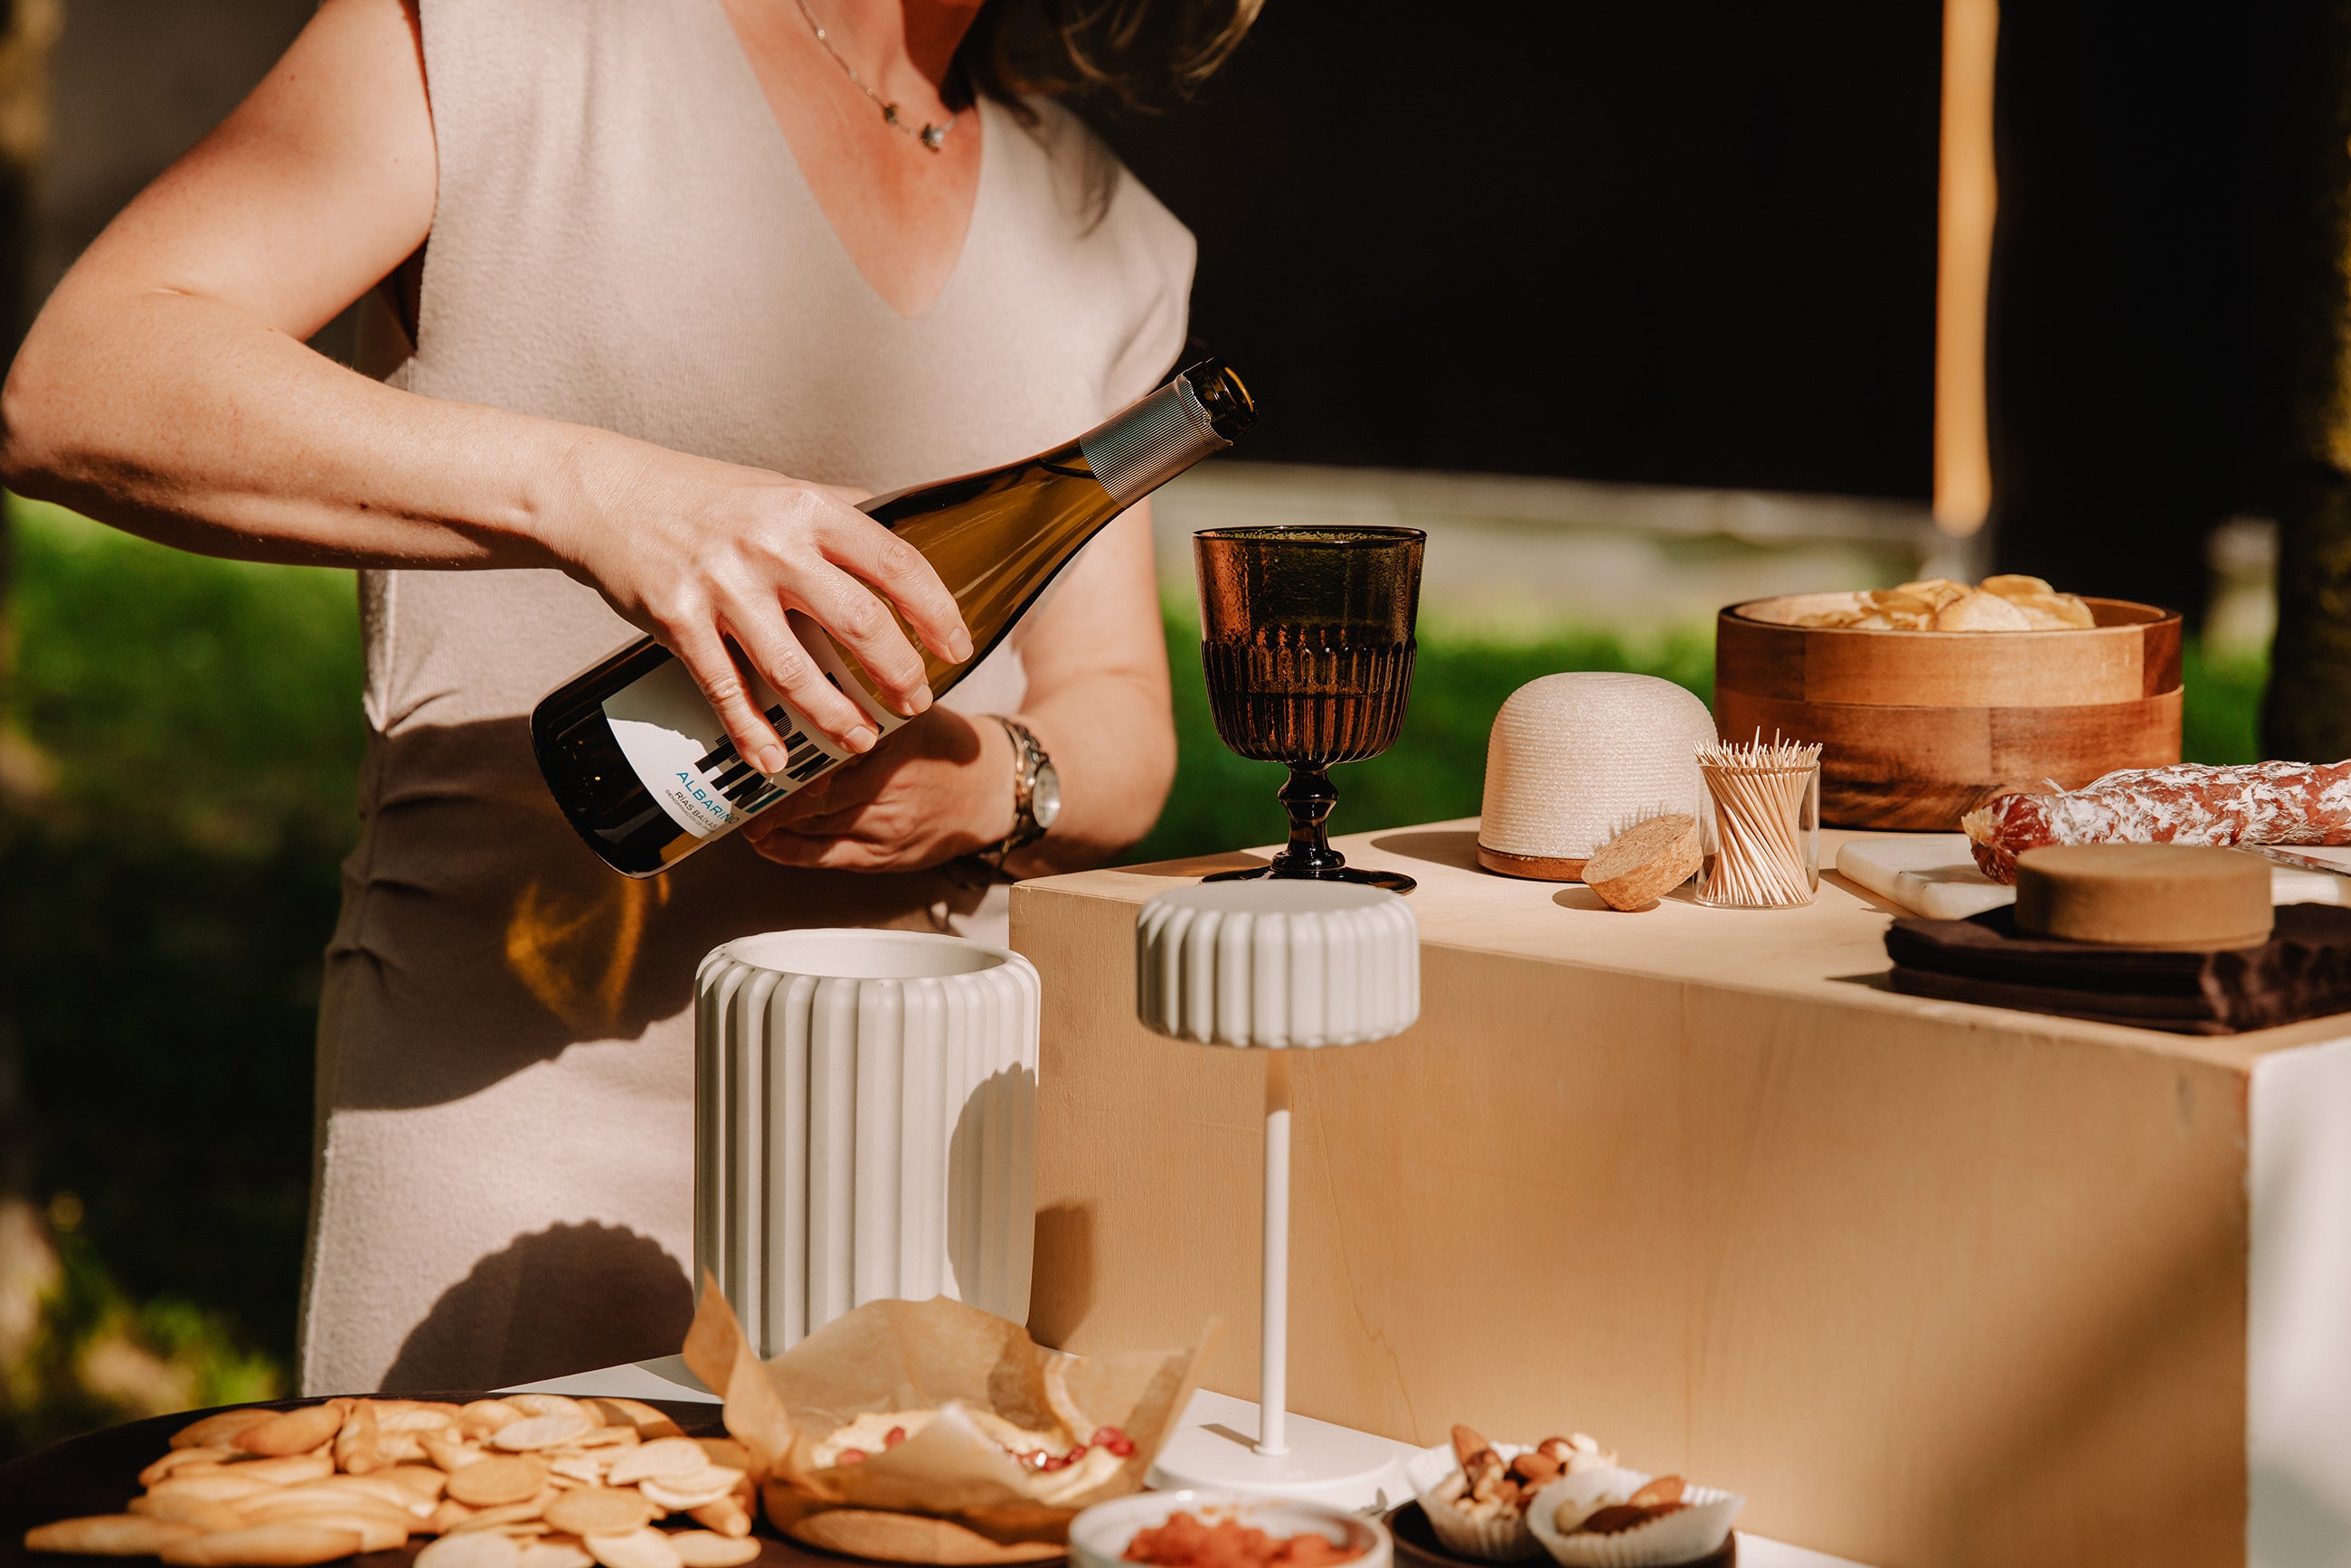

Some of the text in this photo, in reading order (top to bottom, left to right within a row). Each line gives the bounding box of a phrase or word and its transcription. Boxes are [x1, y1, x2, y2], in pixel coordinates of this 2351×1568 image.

[675, 791, 694, 811] RÍAS
[692, 809, 717, 829] BAIXAS
[676, 772, 740, 824] ALBARIÑO
